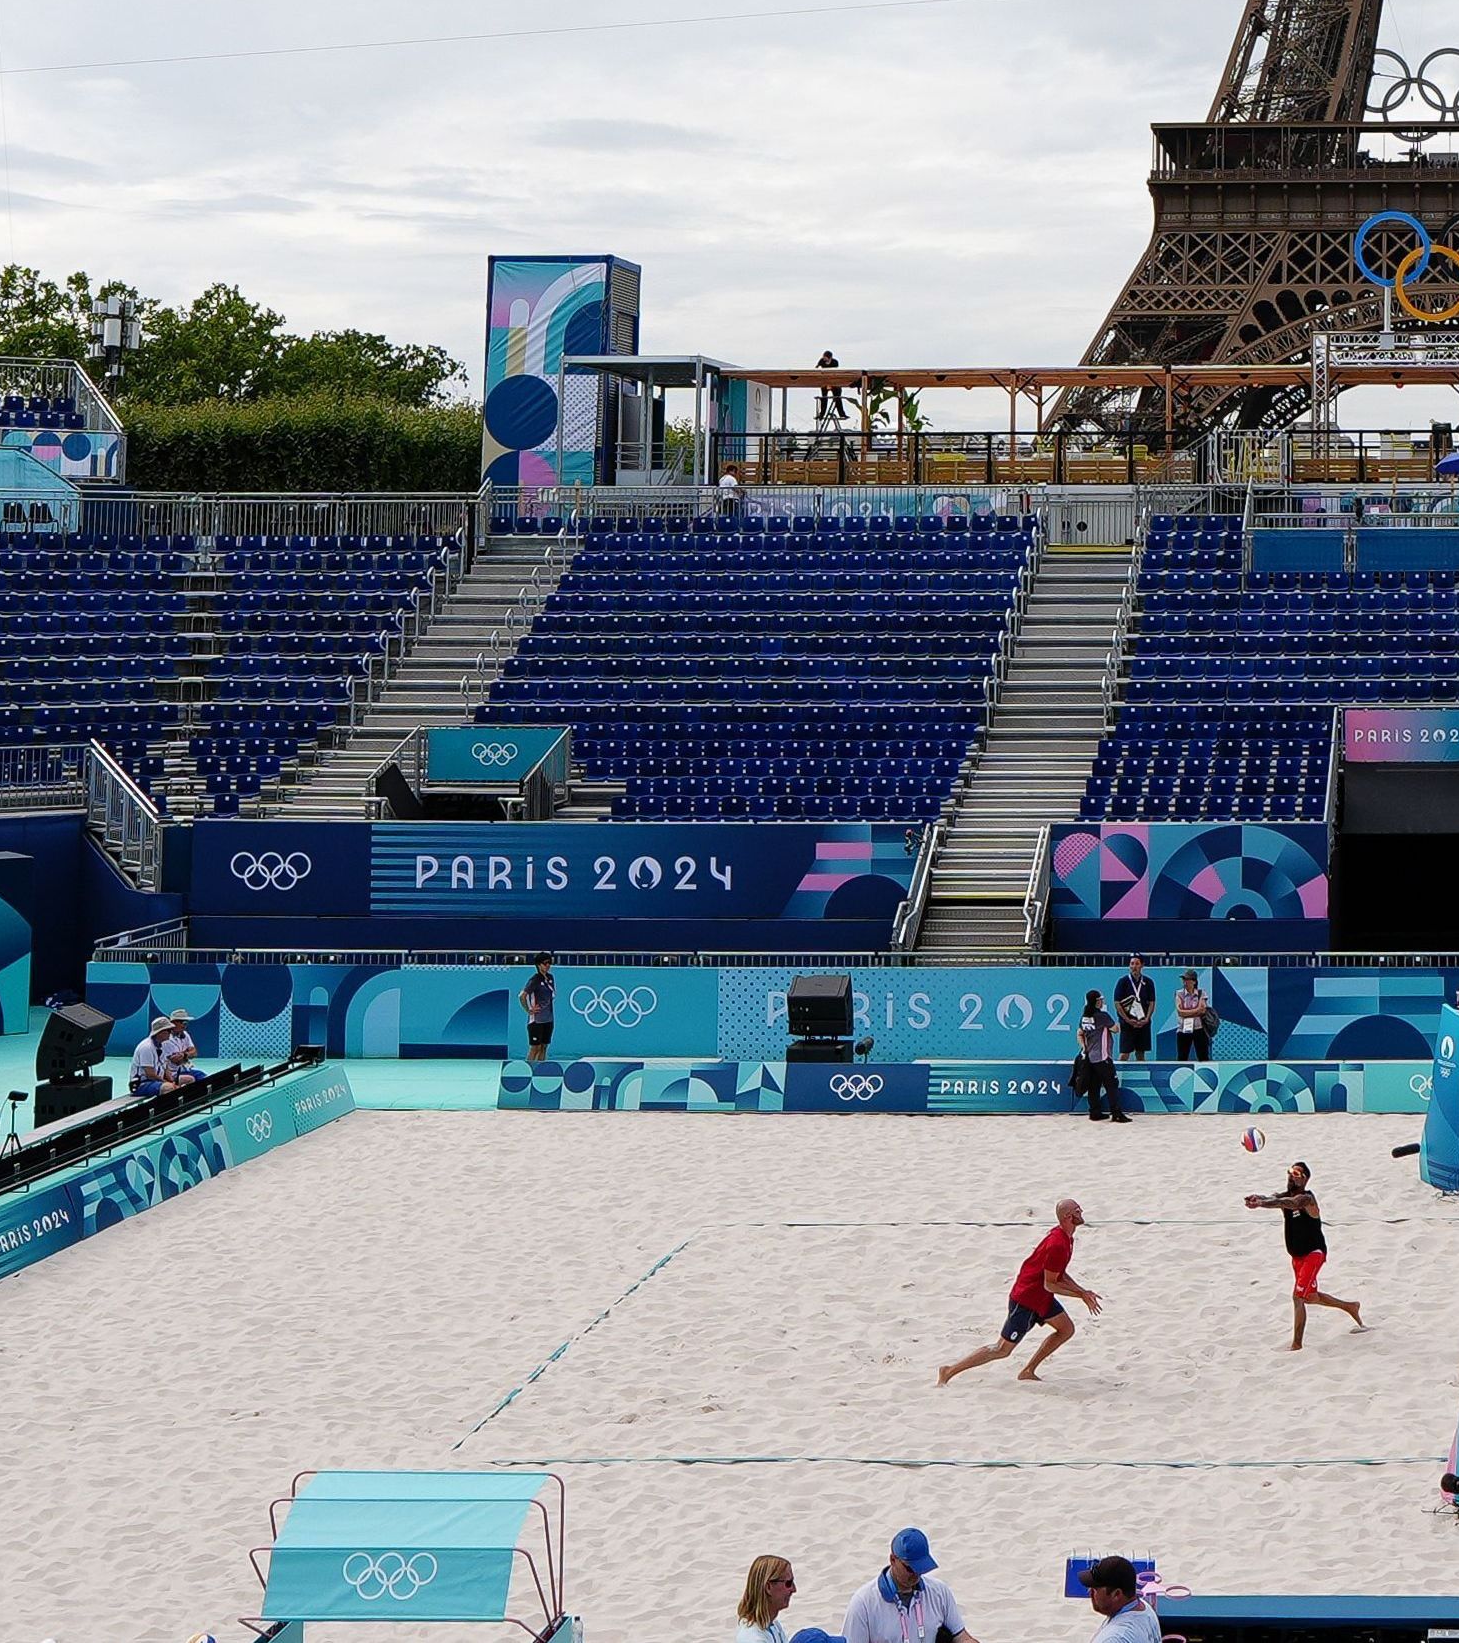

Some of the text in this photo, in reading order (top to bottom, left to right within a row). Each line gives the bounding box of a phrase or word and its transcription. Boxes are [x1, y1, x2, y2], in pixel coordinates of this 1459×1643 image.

[593, 855, 733, 891] 2024
[767, 991, 1071, 1031] PRIS 202
[321, 1083, 347, 1104] 2024
[1006, 1079, 1061, 1095] 2024
[32, 1208, 70, 1237] 2024
